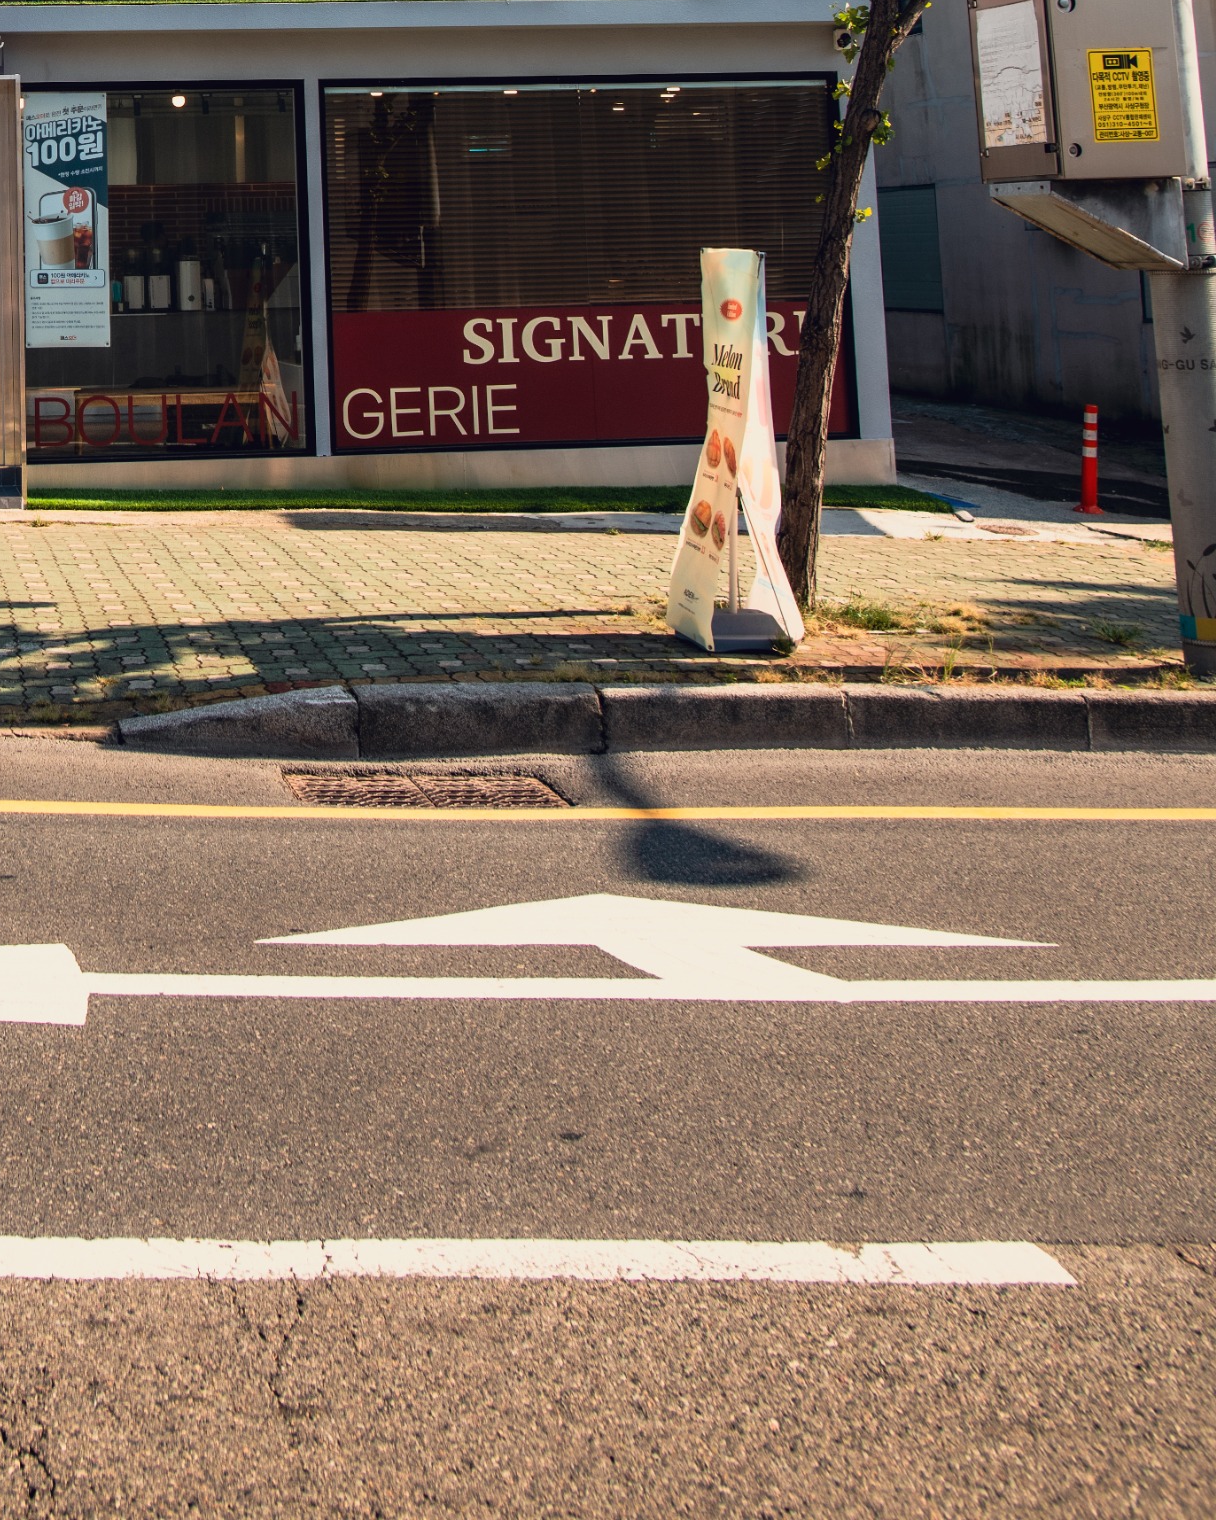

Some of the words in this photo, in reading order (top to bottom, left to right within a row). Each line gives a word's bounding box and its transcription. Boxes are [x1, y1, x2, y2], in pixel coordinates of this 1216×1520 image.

[1112, 71, 1130, 82] CCTV
[25, 115, 103, 141] 아메리카노
[25, 131, 104, 168] 100원
[463, 311, 805, 366] SIGNATR
[710, 343, 743, 371] Melon
[34, 391, 299, 448] BOULAN
[341, 383, 521, 440] GERIE
